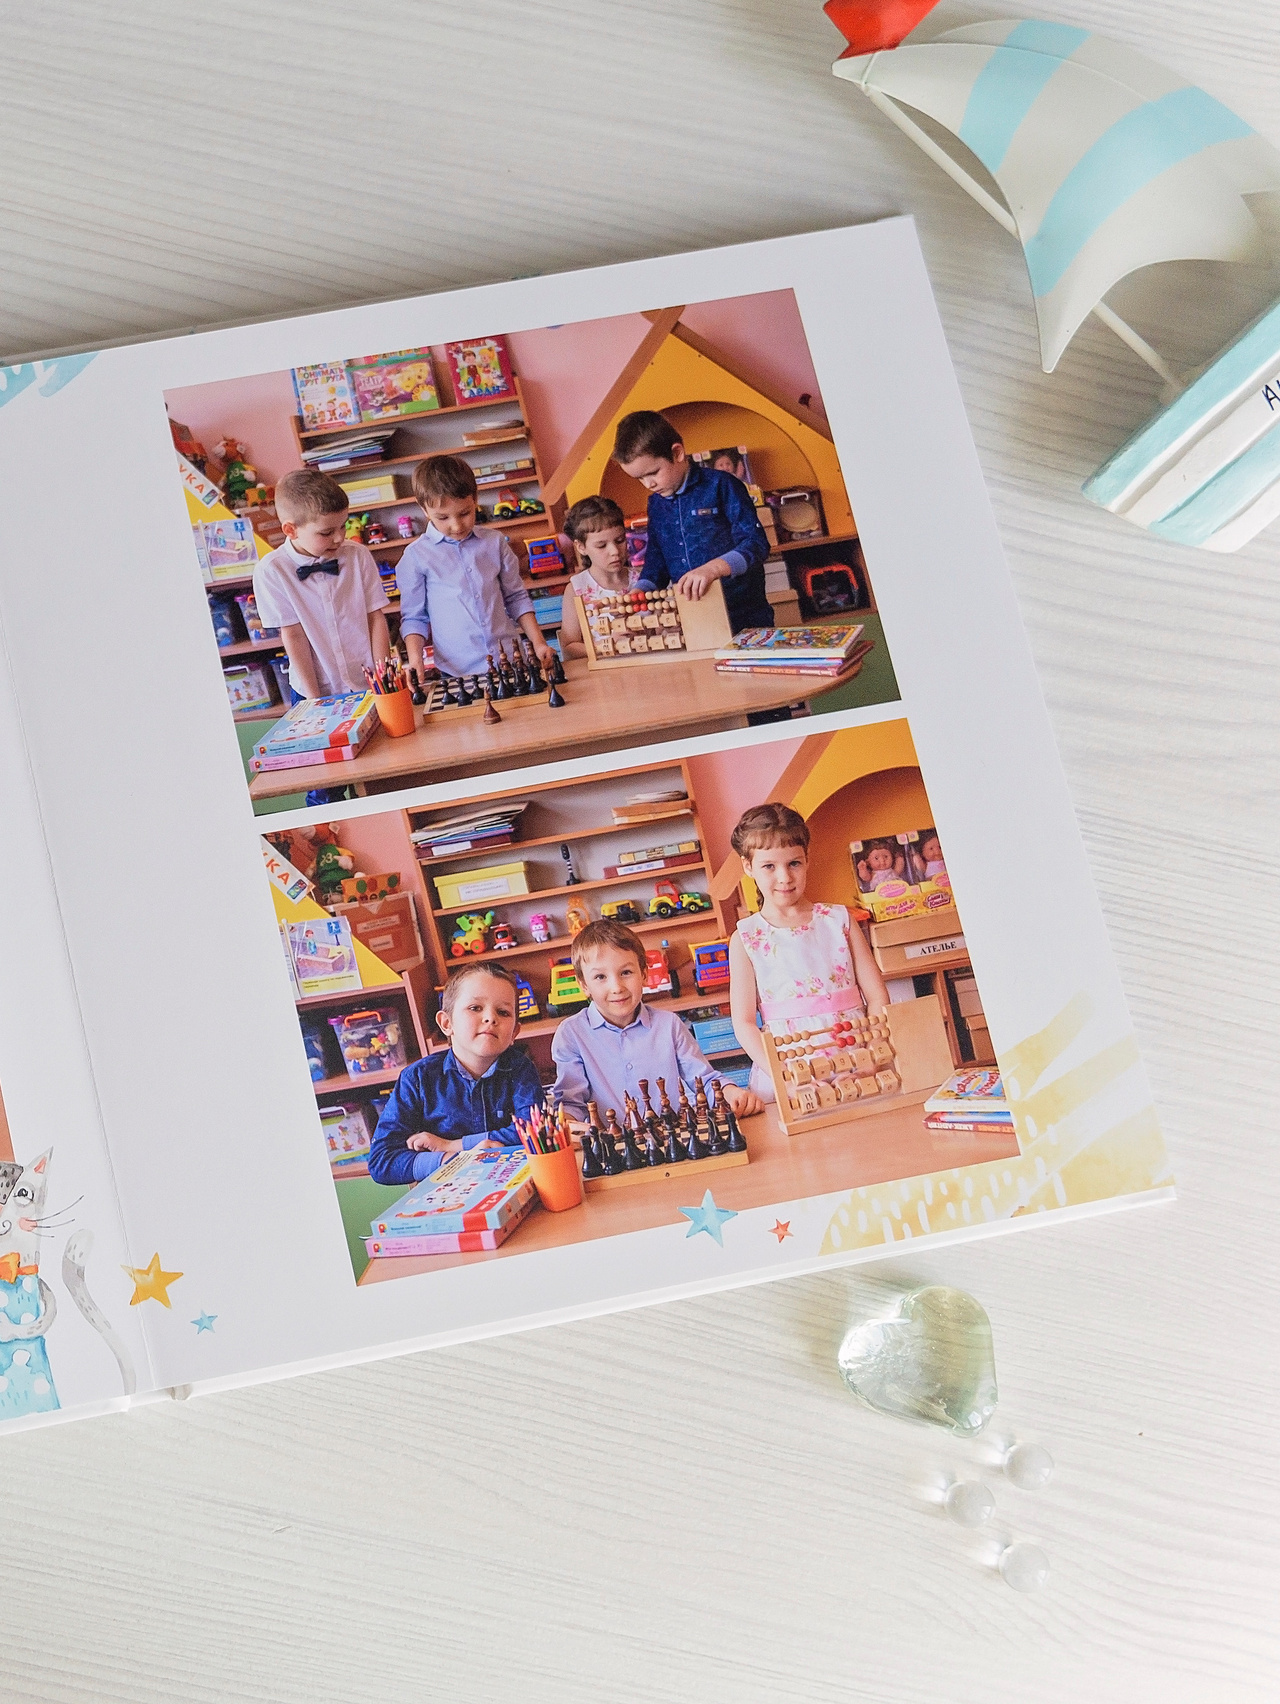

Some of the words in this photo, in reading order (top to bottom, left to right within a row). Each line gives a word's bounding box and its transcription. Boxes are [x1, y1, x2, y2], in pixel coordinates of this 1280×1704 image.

[297, 367, 344, 380] ПОНИМАТЬ
[299, 376, 319, 388] ДРУГ
[321, 374, 345, 385] ДРУГА
[920, 941, 957, 955] АТЕЛЬЕ
